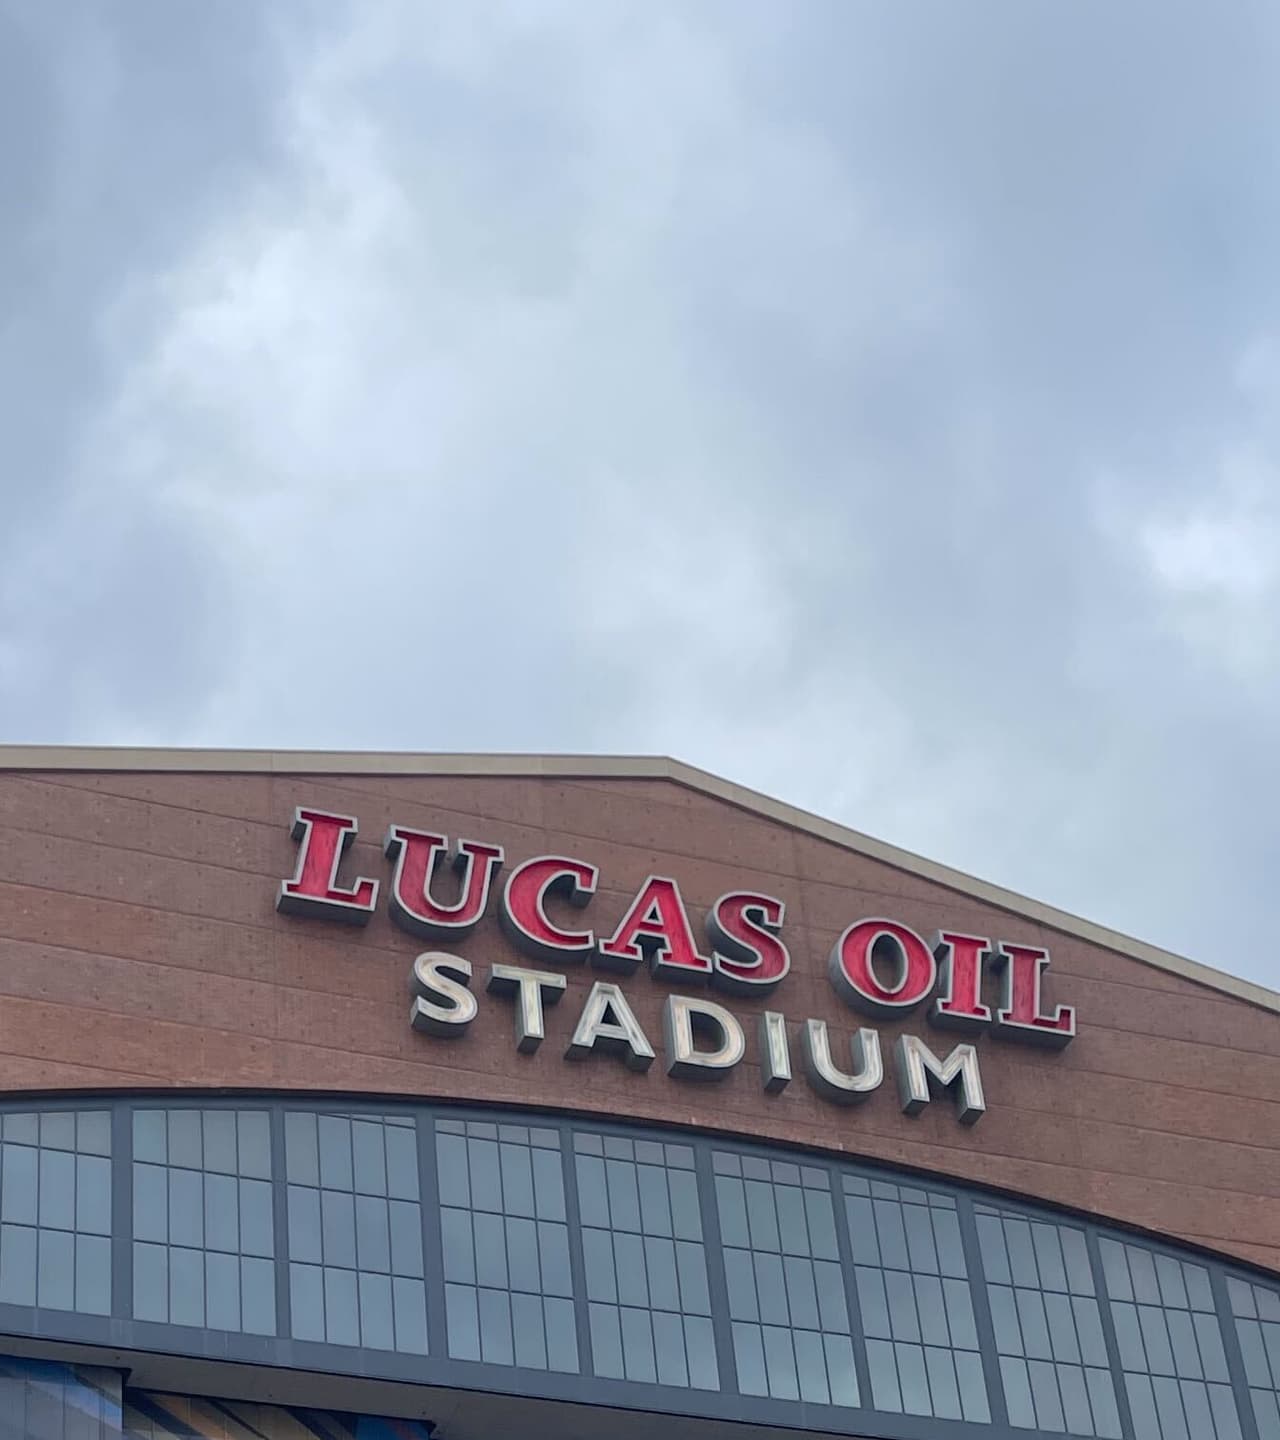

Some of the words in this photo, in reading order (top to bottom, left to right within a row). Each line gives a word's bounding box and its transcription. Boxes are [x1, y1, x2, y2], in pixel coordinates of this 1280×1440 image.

[277, 806, 791, 997] LUCAS
[830, 916, 1077, 1050] OIL
[410, 951, 986, 1124] STADIUM
